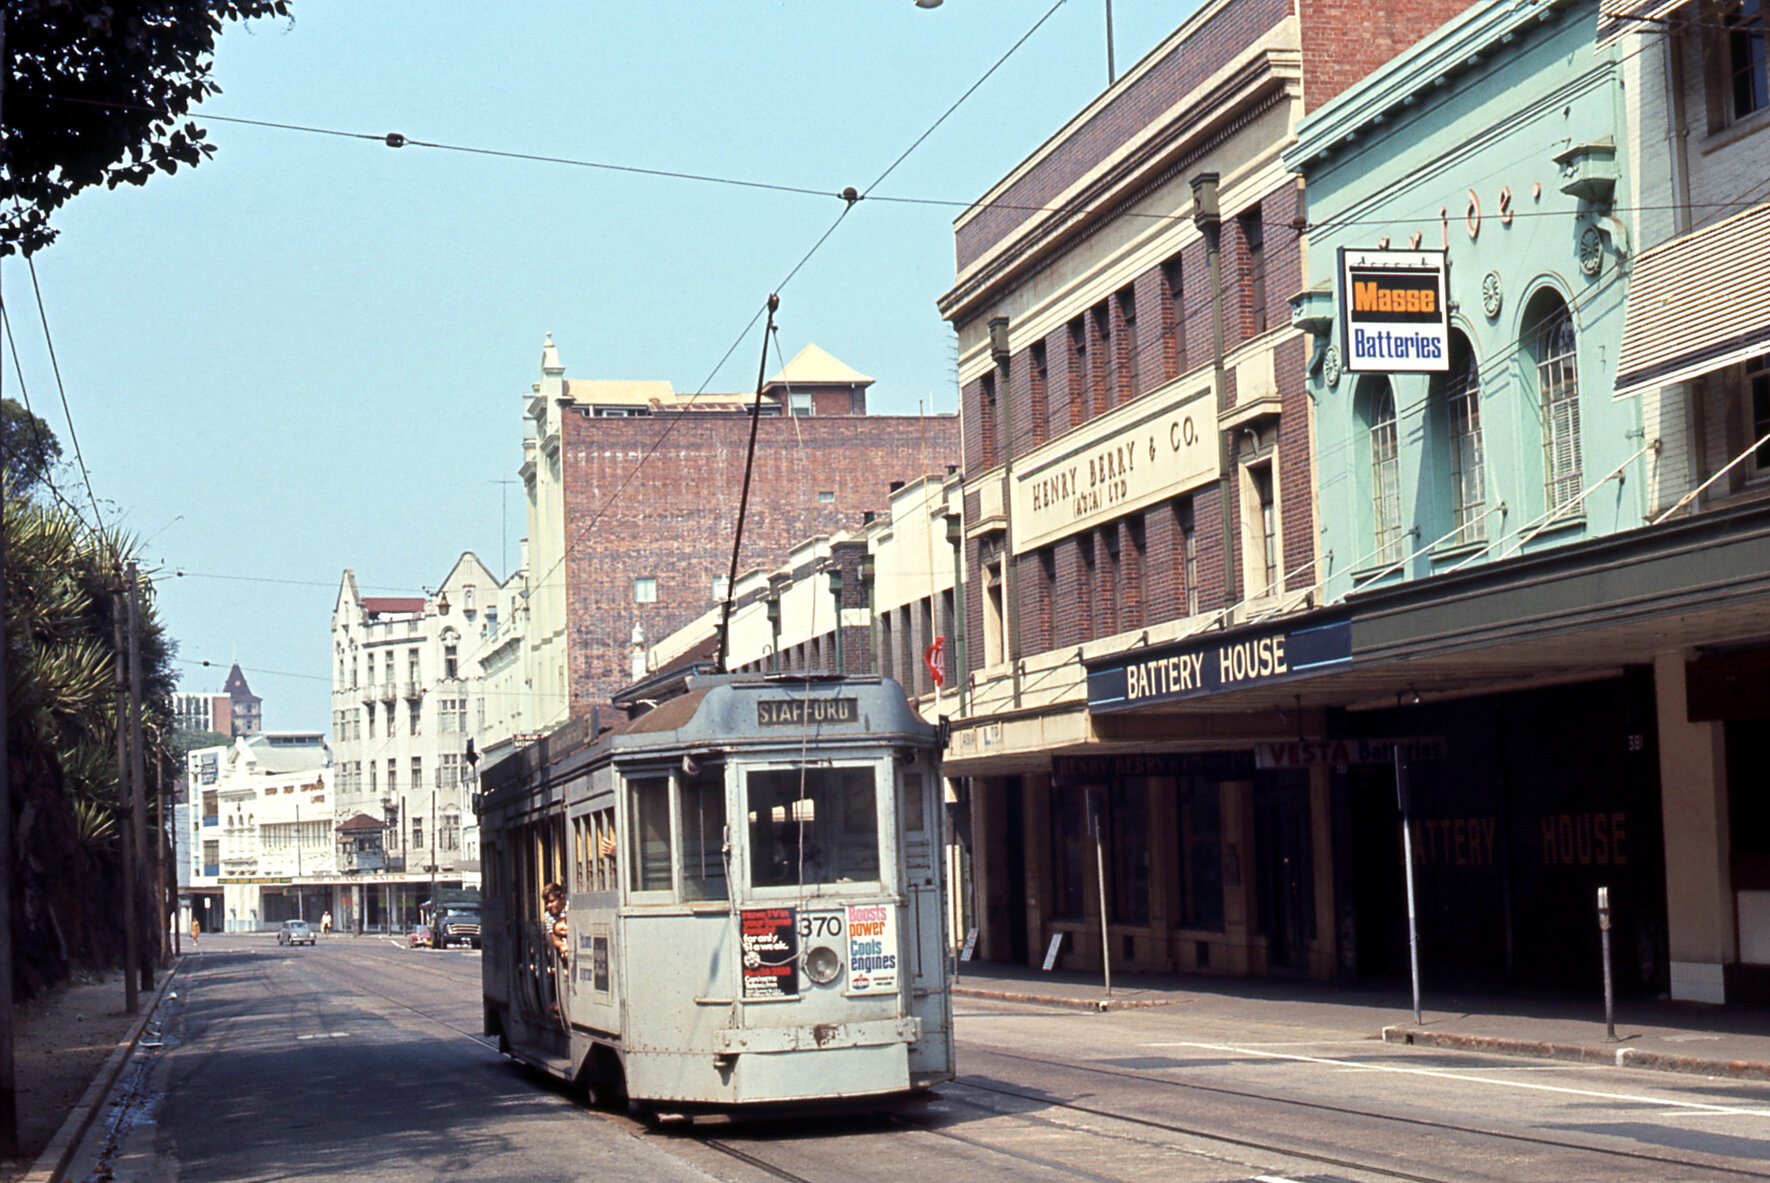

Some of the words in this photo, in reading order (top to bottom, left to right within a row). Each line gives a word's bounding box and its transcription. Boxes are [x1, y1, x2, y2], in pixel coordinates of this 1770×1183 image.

[1355, 282, 1435, 312] Masse
[1354, 328, 1442, 358] Batteries
[1033, 466, 1078, 512] HENRY
[1089, 441, 1135, 488] BERRY
[1149, 436, 1156, 462] &
[1170, 416, 1199, 452] CO.
[1108, 479, 1127, 502] LTD
[1126, 652, 1205, 700] BATTERY
[1219, 634, 1288, 683] HOUSE
[1268, 742, 1349, 765] VESTA
[1359, 741, 1441, 761] Battries
[1400, 816, 1495, 866] ATTERY
[1540, 812, 1629, 865] HOUSE
[848, 905, 887, 923] Boosts
[797, 916, 842, 938] 370
[849, 921, 886, 941] power
[850, 939, 882, 957] Cools
[851, 954, 896, 974] engines
